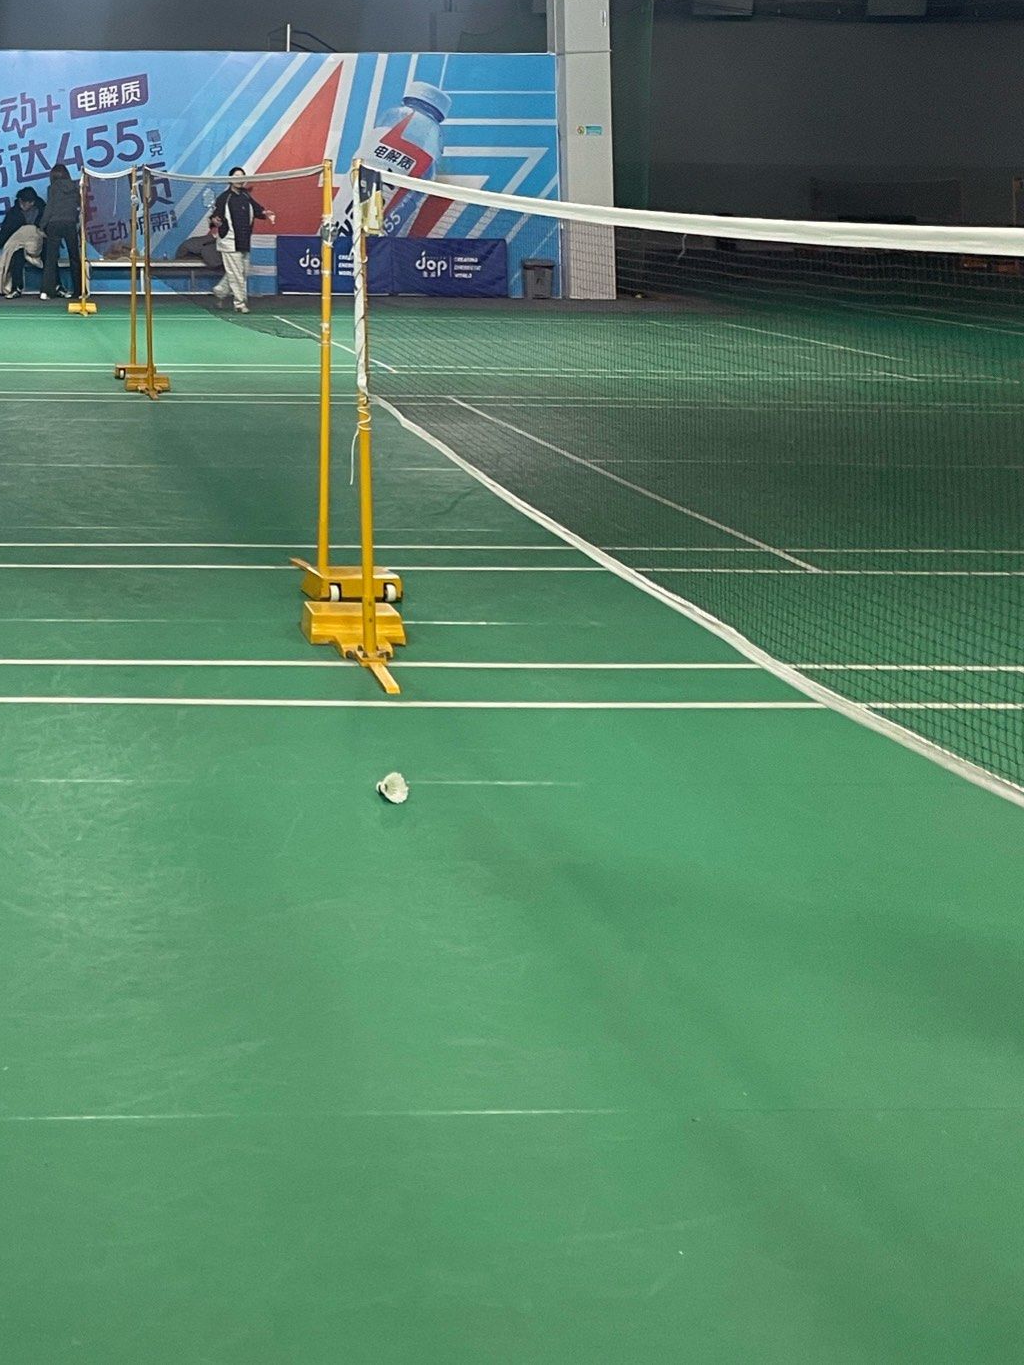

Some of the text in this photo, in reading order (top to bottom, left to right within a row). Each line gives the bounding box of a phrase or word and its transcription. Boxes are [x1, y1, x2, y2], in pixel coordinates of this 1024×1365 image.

[75, 79, 142, 113] 电解质
[373, 145, 416, 170] 电解质
[383, 211, 401, 234] 55
